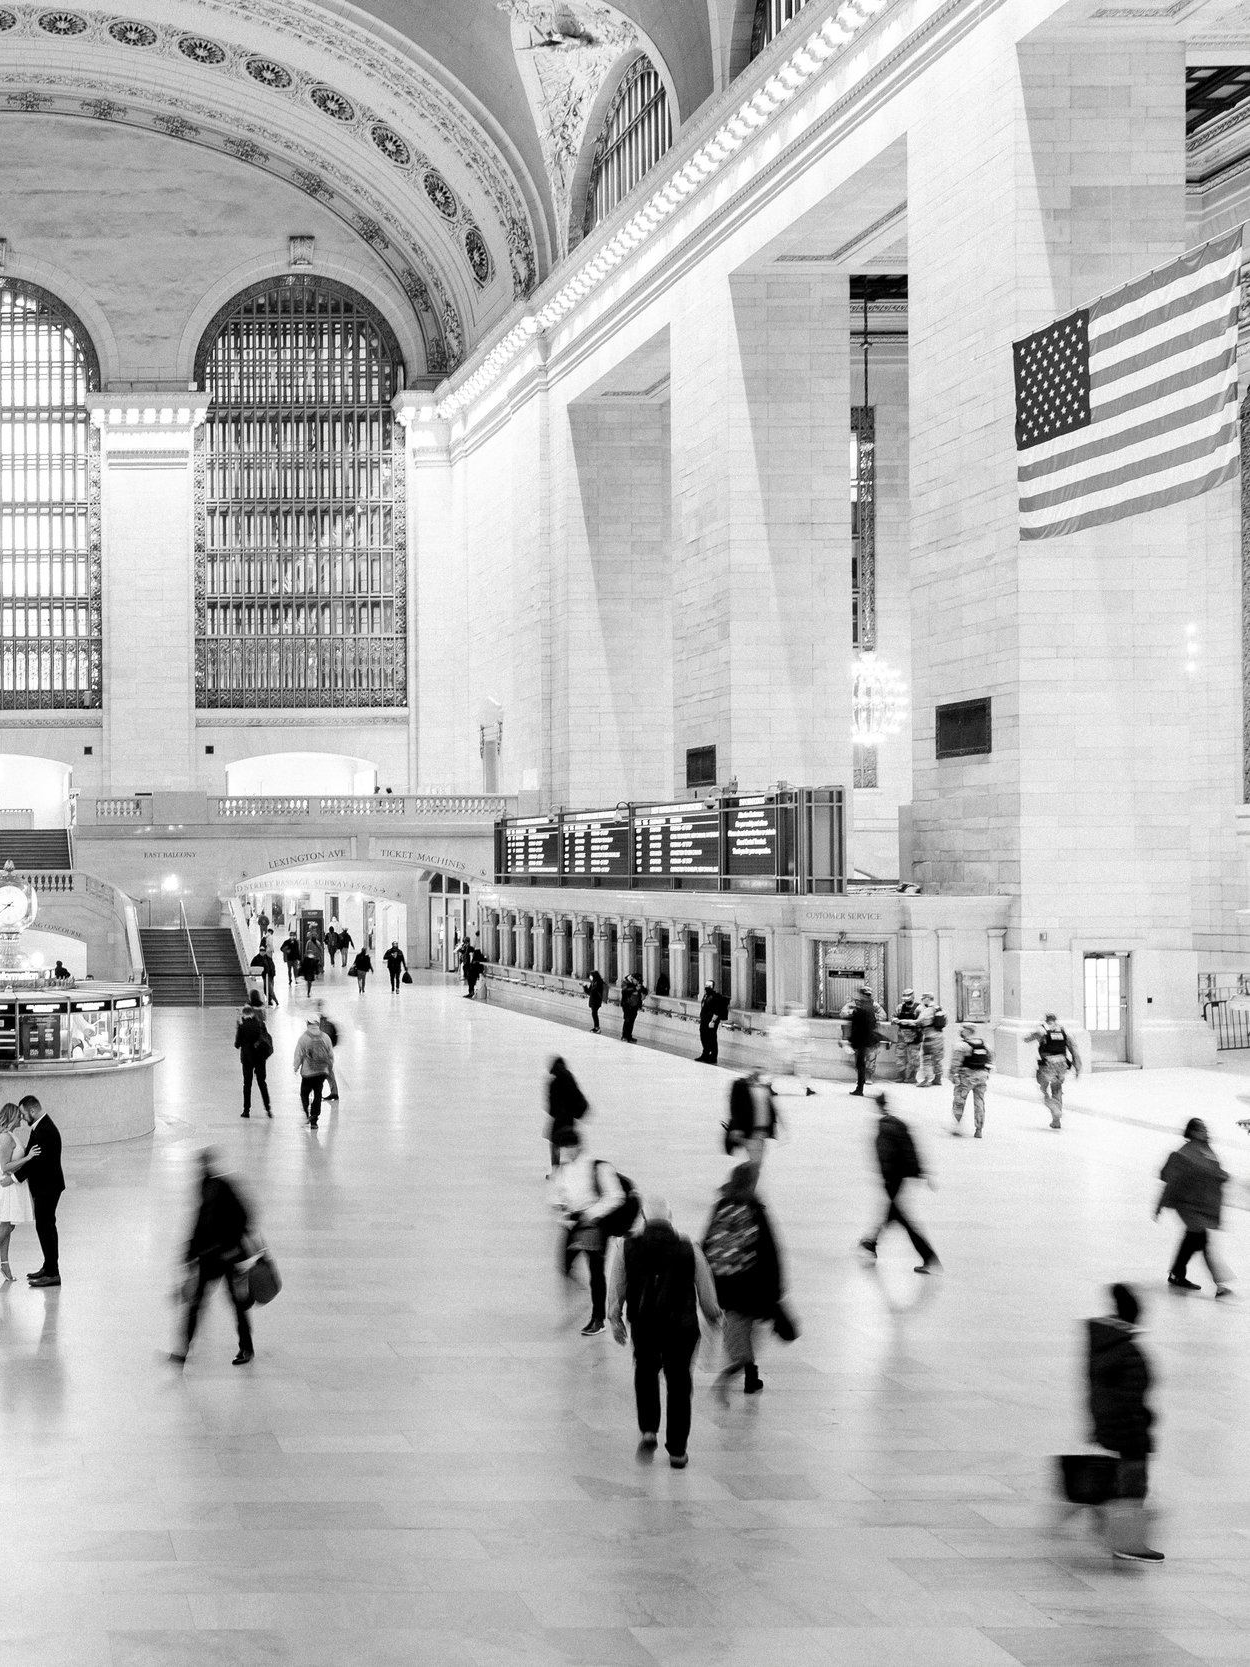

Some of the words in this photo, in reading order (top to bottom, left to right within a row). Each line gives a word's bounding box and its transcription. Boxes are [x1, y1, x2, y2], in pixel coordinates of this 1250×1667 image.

[143, 851, 160, 859] EAST
[163, 851, 198, 859] BALCONY
[268, 850, 325, 869] LEXINGTON
[327, 848, 347, 858] AVE
[379, 849, 414, 859] TICKET
[417, 853, 466, 870] MACHINES
[244, 881, 274, 890] STREET
[806, 912, 846, 920] CUSTOMER
[847, 912, 883, 920] SERVICE
[44, 924, 82, 938] CONCOURSE
